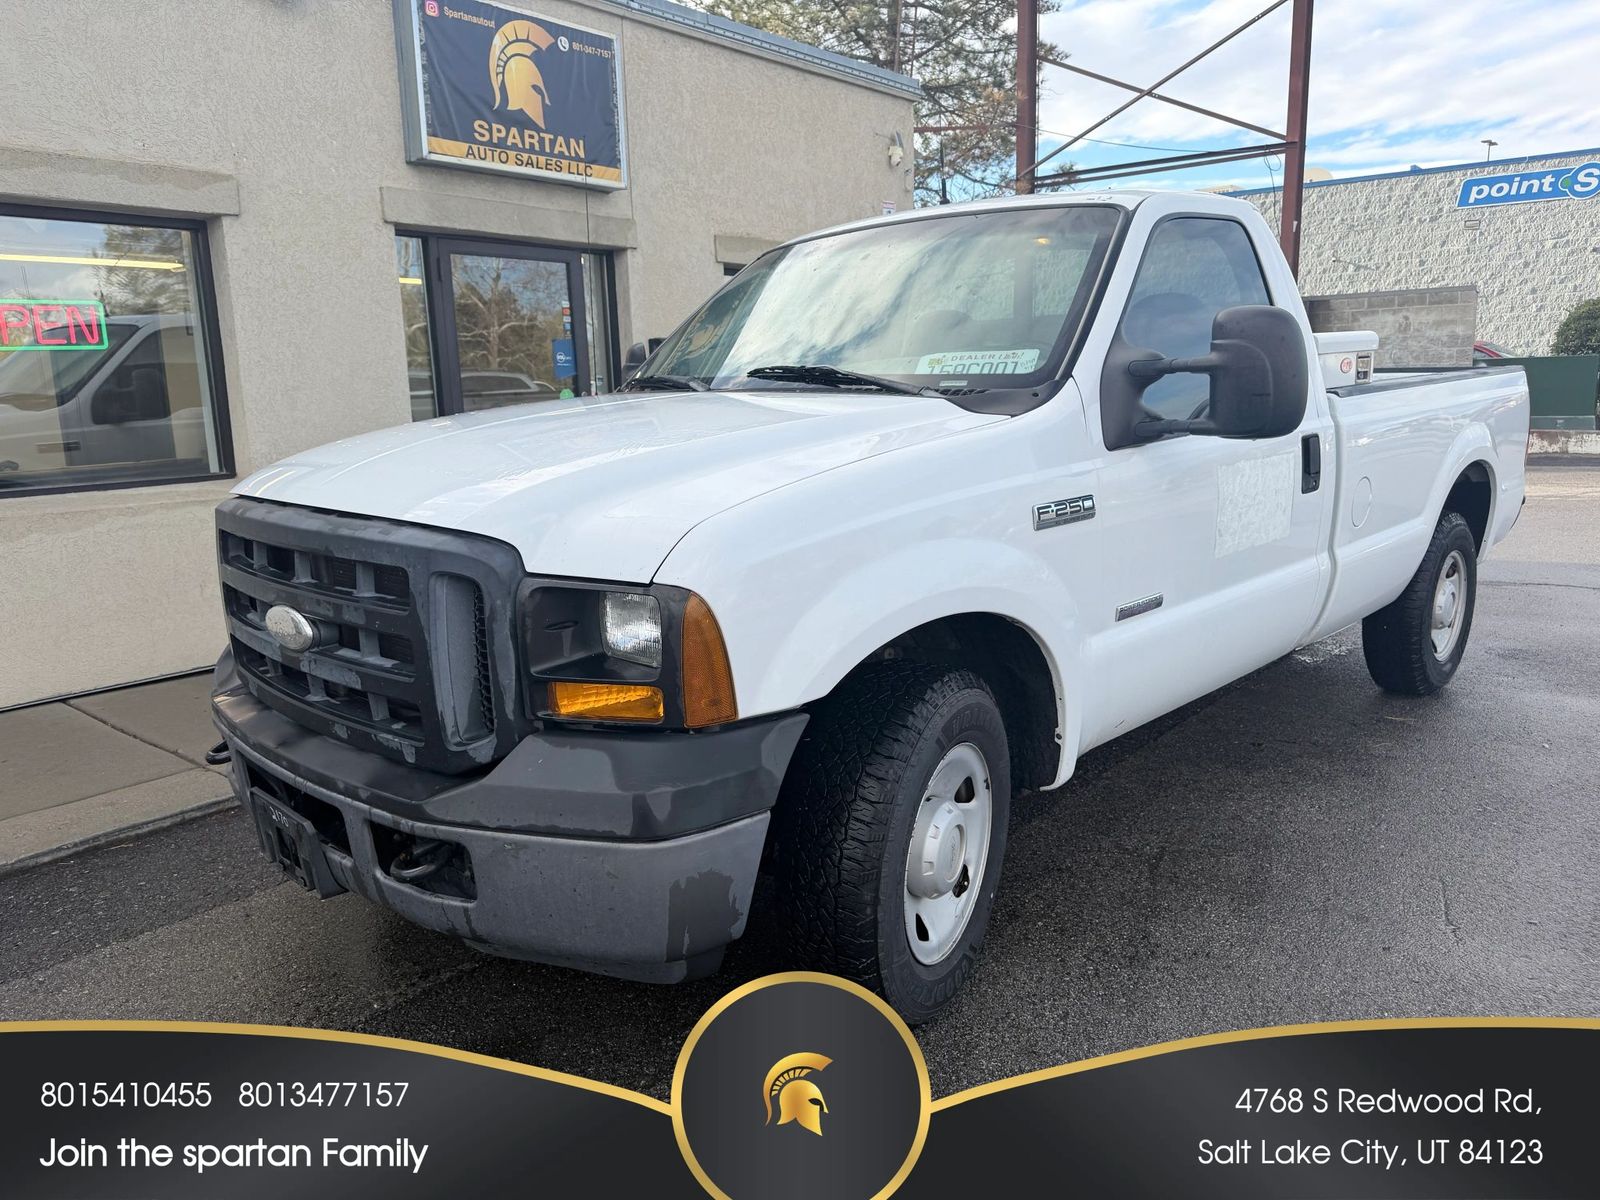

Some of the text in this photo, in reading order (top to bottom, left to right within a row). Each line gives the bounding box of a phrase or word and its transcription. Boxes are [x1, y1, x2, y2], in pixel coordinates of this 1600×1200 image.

[473, 119, 586, 159] SPARTAN
[465, 144, 593, 178] AUTO SALES LLC
[1468, 173, 1556, 204] point
[951, 353, 996, 361] DEALER
